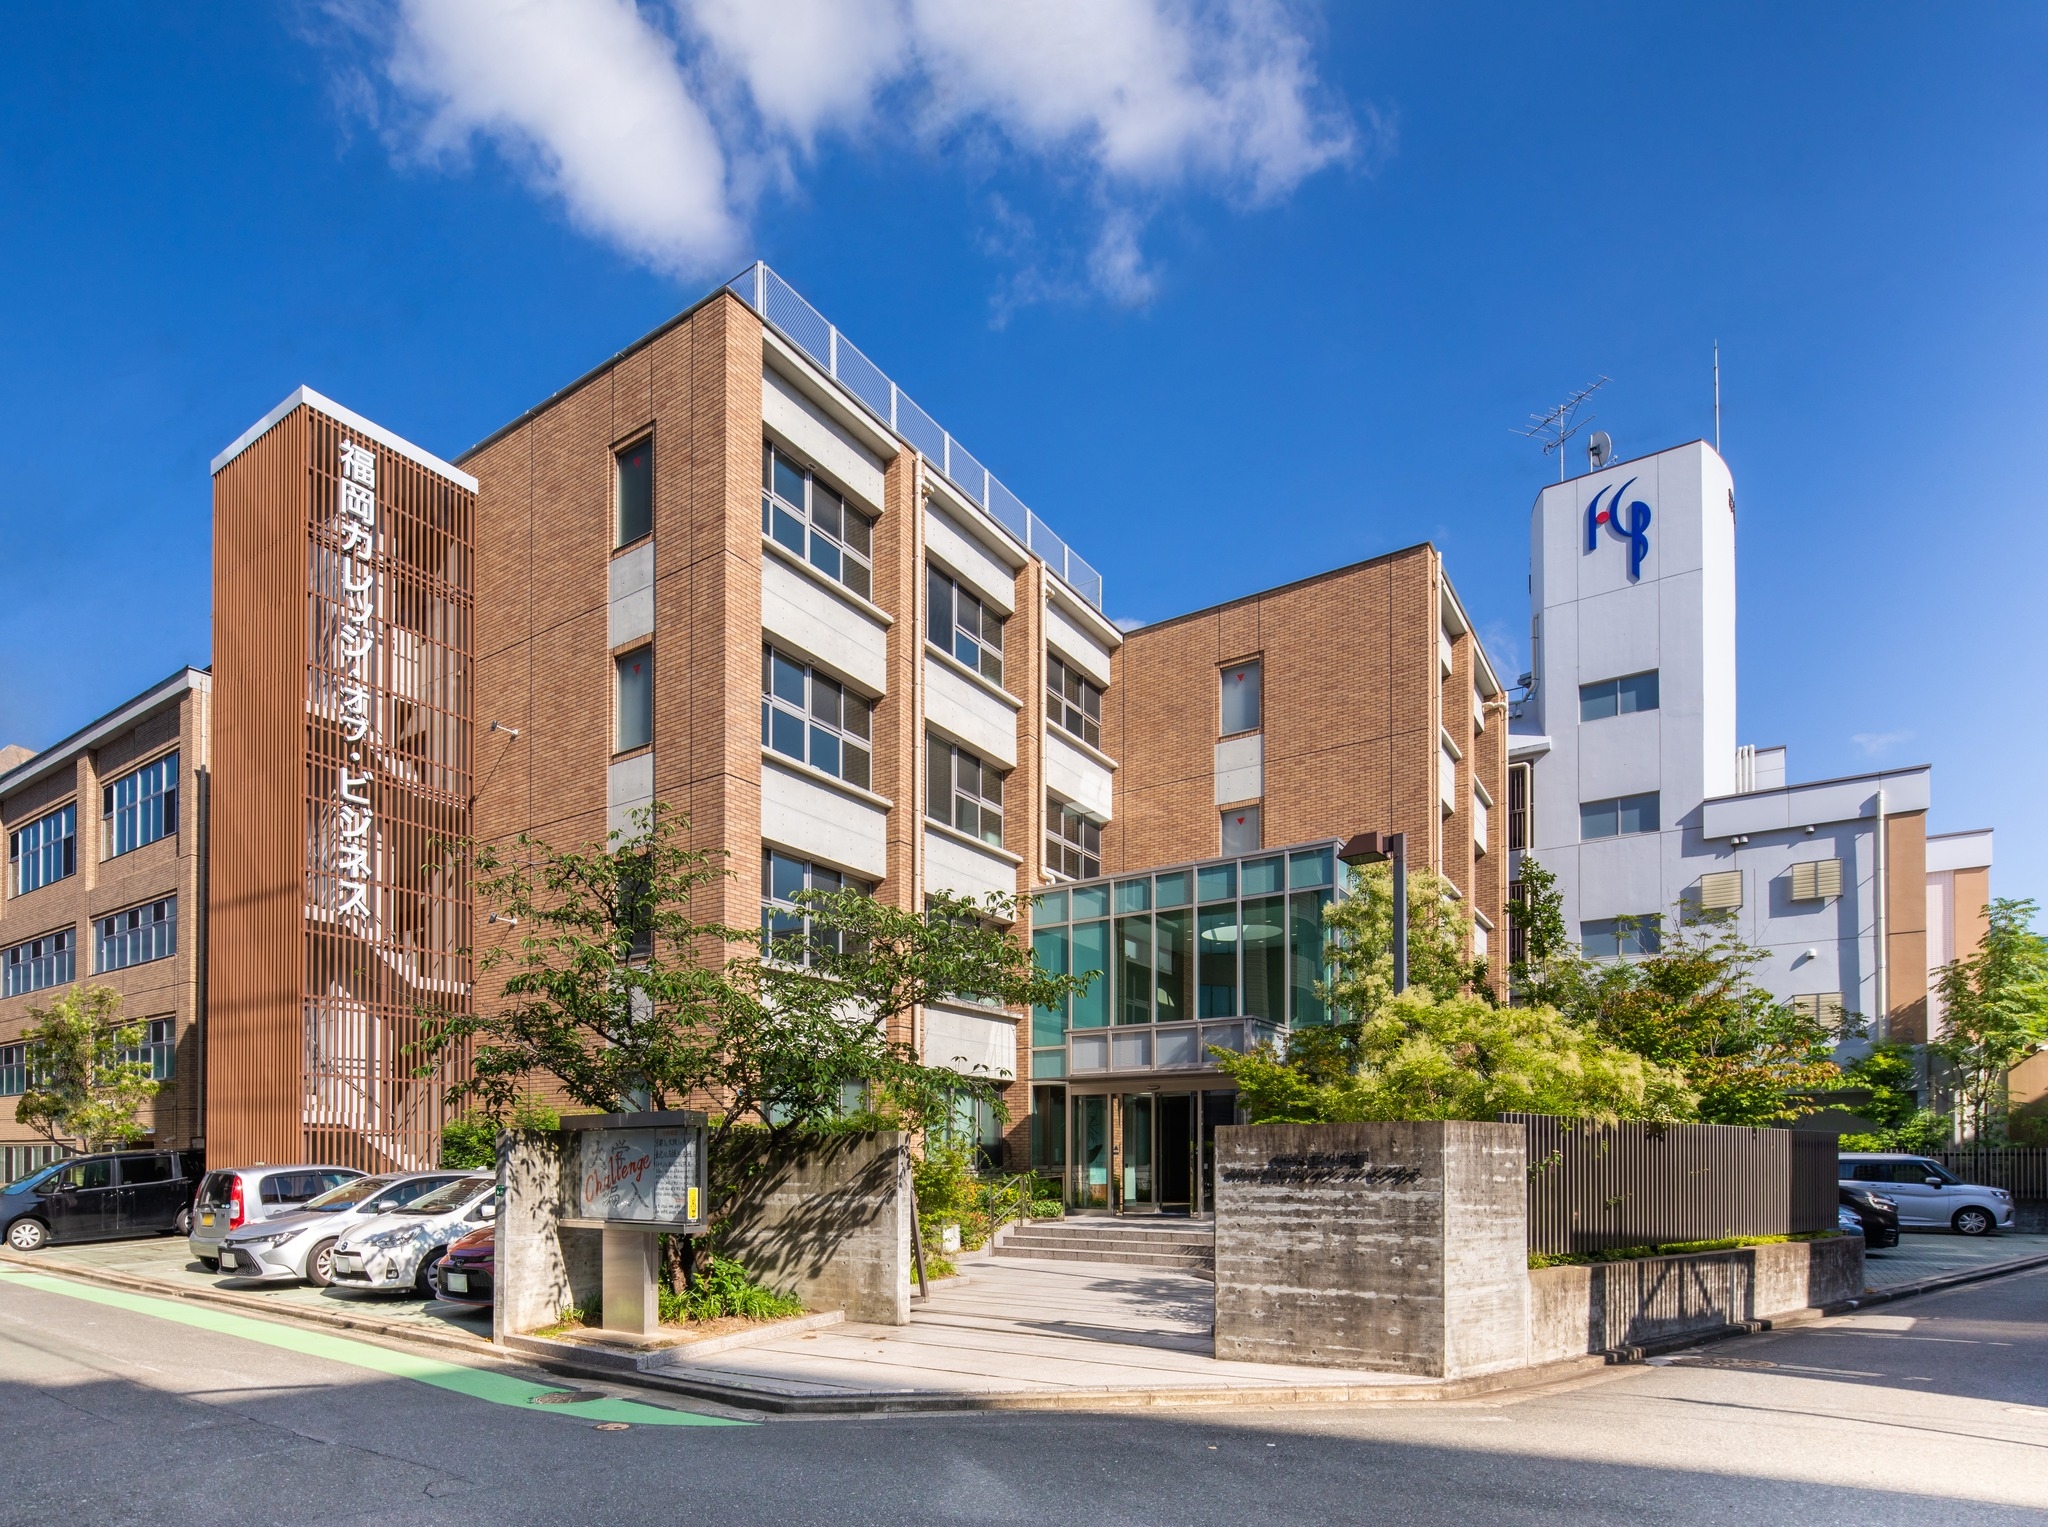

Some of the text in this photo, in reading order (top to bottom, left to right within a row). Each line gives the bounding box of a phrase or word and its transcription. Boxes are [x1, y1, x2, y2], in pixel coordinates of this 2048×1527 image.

[338, 438, 376, 916] 福岡カレッジ・オブ・ビジネス
[585, 1154, 652, 1203] Challenge
